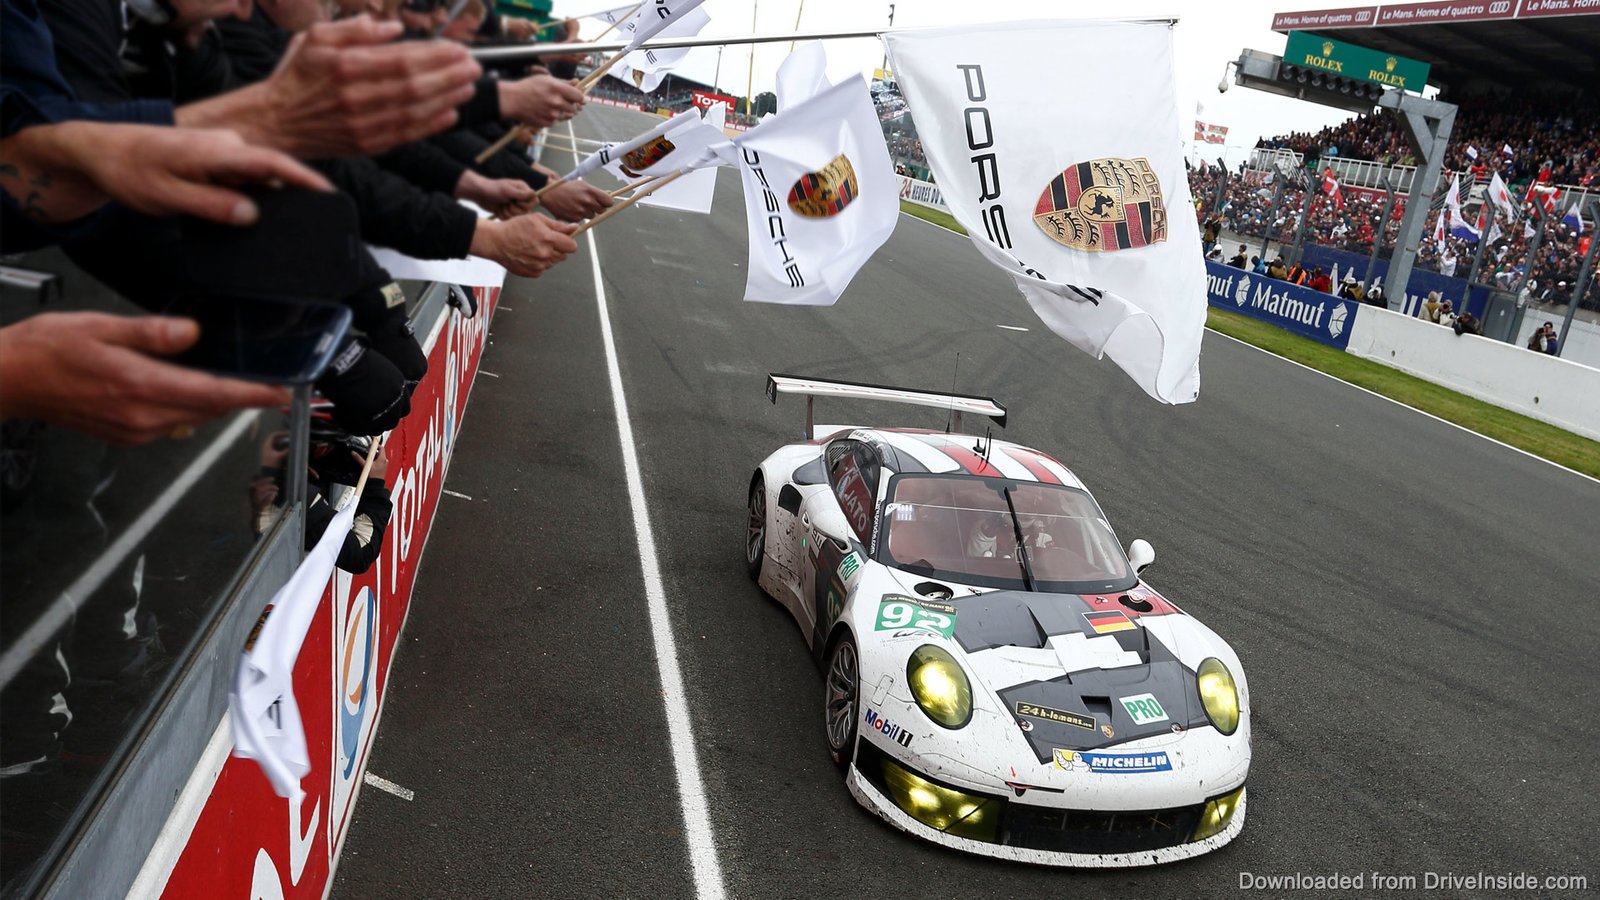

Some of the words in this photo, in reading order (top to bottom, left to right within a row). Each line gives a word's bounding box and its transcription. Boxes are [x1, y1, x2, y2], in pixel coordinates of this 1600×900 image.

[1382, 10, 1392, 20] Le
[1393, 9, 1414, 19] Mans.
[1416, 7, 1440, 17] Home
[1441, 7, 1451, 16] of
[1451, 5, 1484, 18] quattro
[1527, 1, 1538, 11] Le
[1540, 0, 1570, 10] Mans.
[1573, 0, 1600, 8] Hom
[1276, 16, 1283, 25] Le
[1283, 16, 1300, 25] Mans.
[1301, 15, 1319, 24] Home
[1320, 14, 1328, 23] of
[1328, 13, 1352, 24] quattro
[1305, 54, 1343, 72] ROLEX
[1368, 70, 1406, 87] ROLEX
[695, 93, 735, 111] TOTL
[900, 178, 913, 199] 24
[1134, 160, 1165, 241] PORSCHE
[743, 147, 805, 288] ORSCHE
[1206, 273, 1233, 299] mut
[1251, 281, 1325, 328] Matmut
[388, 397, 442, 595] TOTAL
[839, 554, 860, 581] PRO
[881, 602, 951, 637] 92
[1124, 697, 1165, 721] PRO
[865, 708, 901, 740] Mobil
[1091, 754, 1168, 768] MICHELIN
